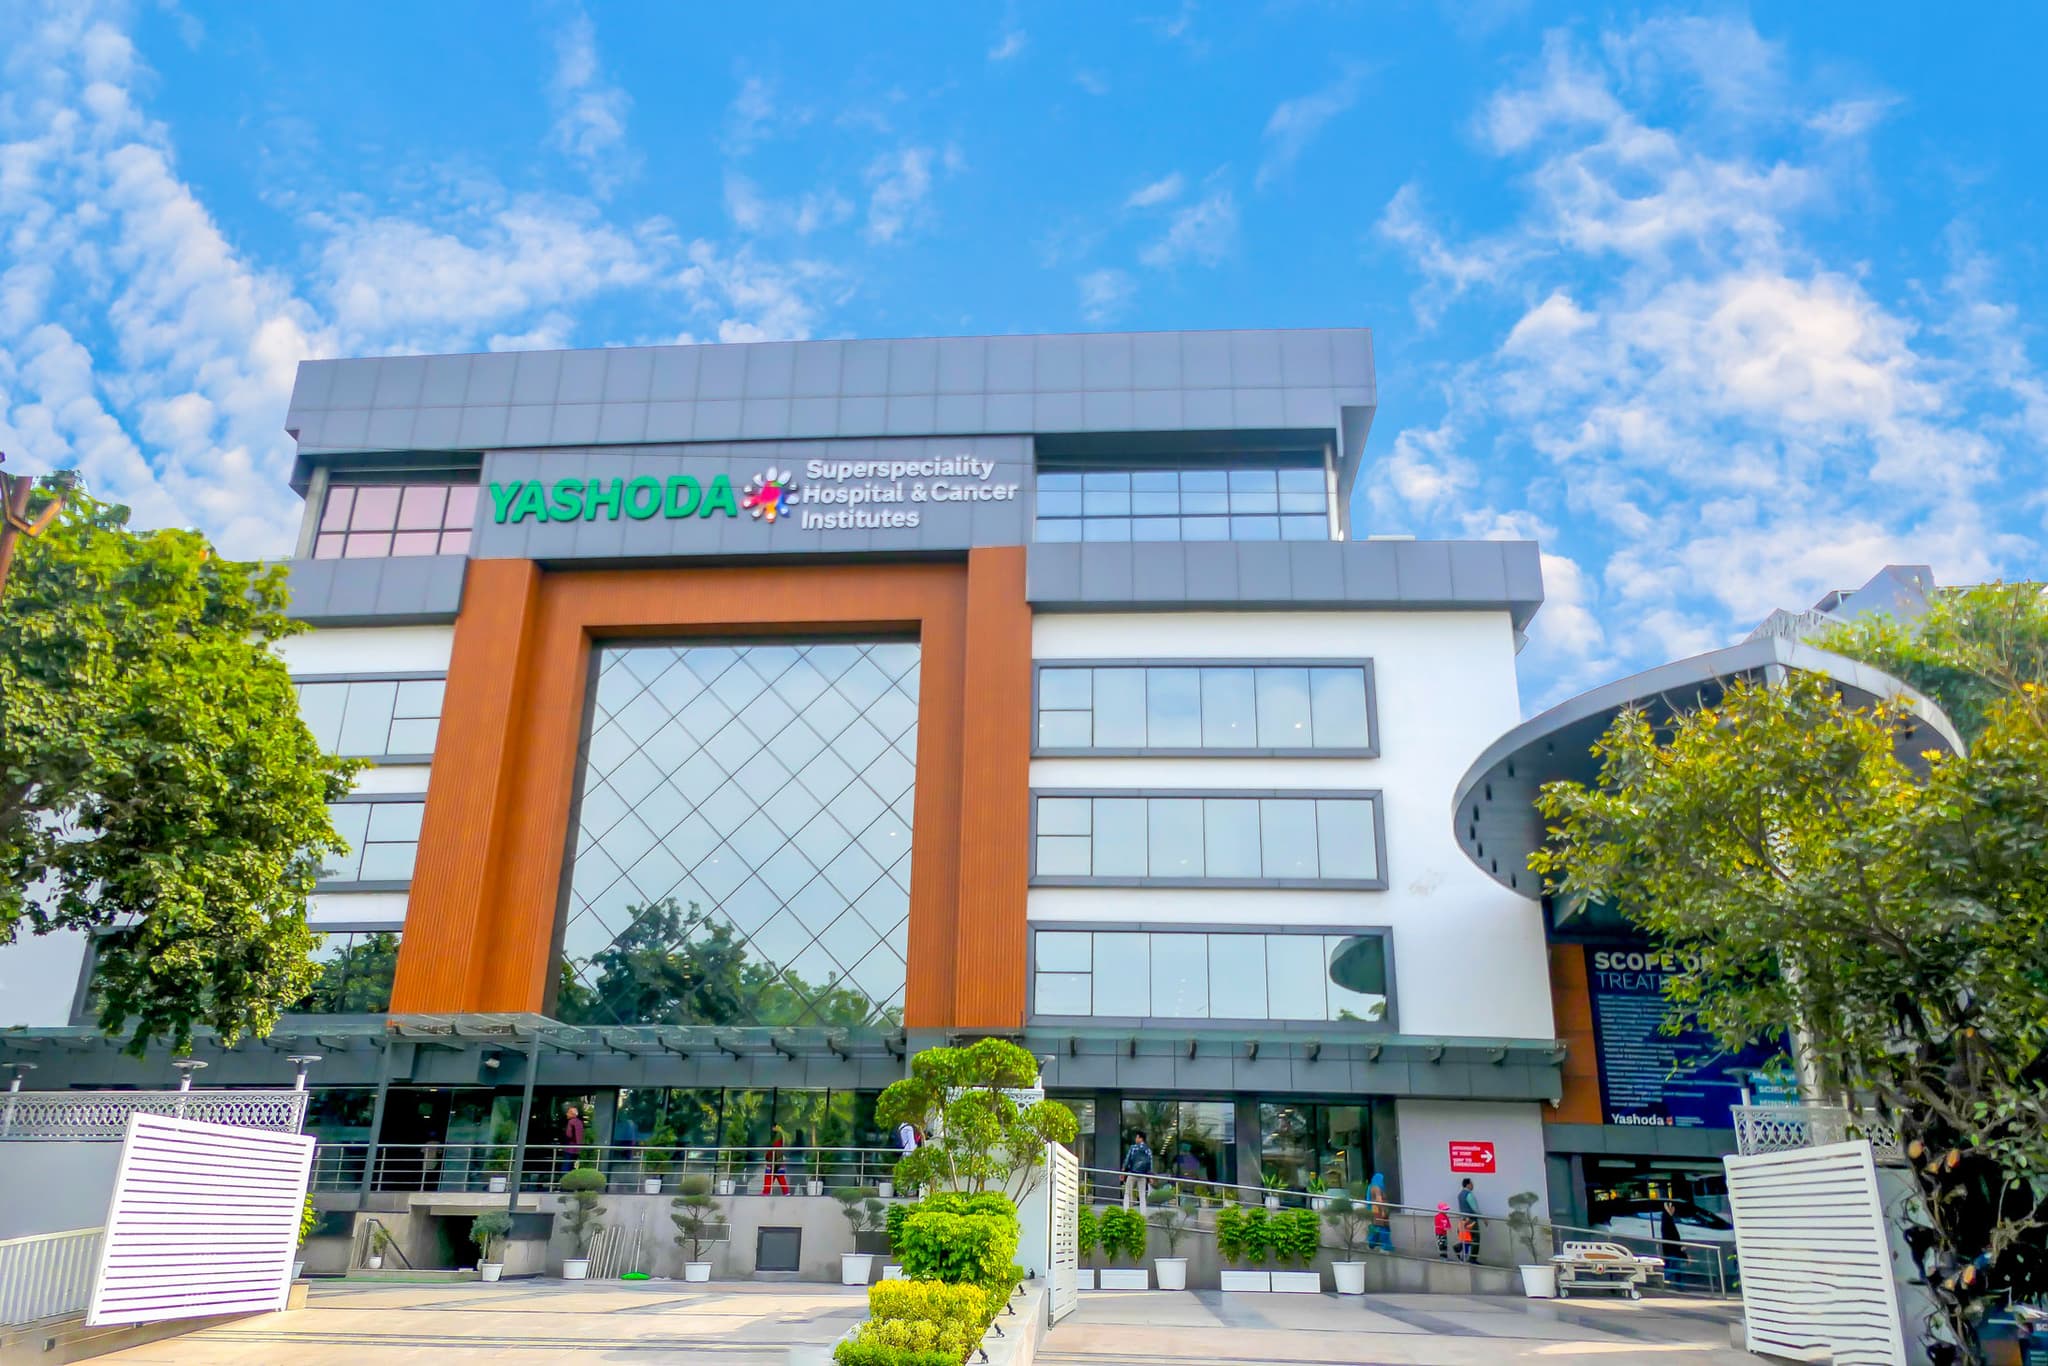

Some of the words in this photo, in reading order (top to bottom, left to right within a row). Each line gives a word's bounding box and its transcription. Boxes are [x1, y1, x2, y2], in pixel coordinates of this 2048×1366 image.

[806, 456, 995, 483] Superspeciality
[489, 474, 738, 524] YASHODA
[802, 482, 905, 508] Hospital
[910, 482, 928, 503] &
[930, 480, 1018, 502] Cancer
[801, 508, 921, 530] Institutes
[1594, 951, 1677, 972] SCOPE
[1611, 1113, 1665, 1126] Yashoda
